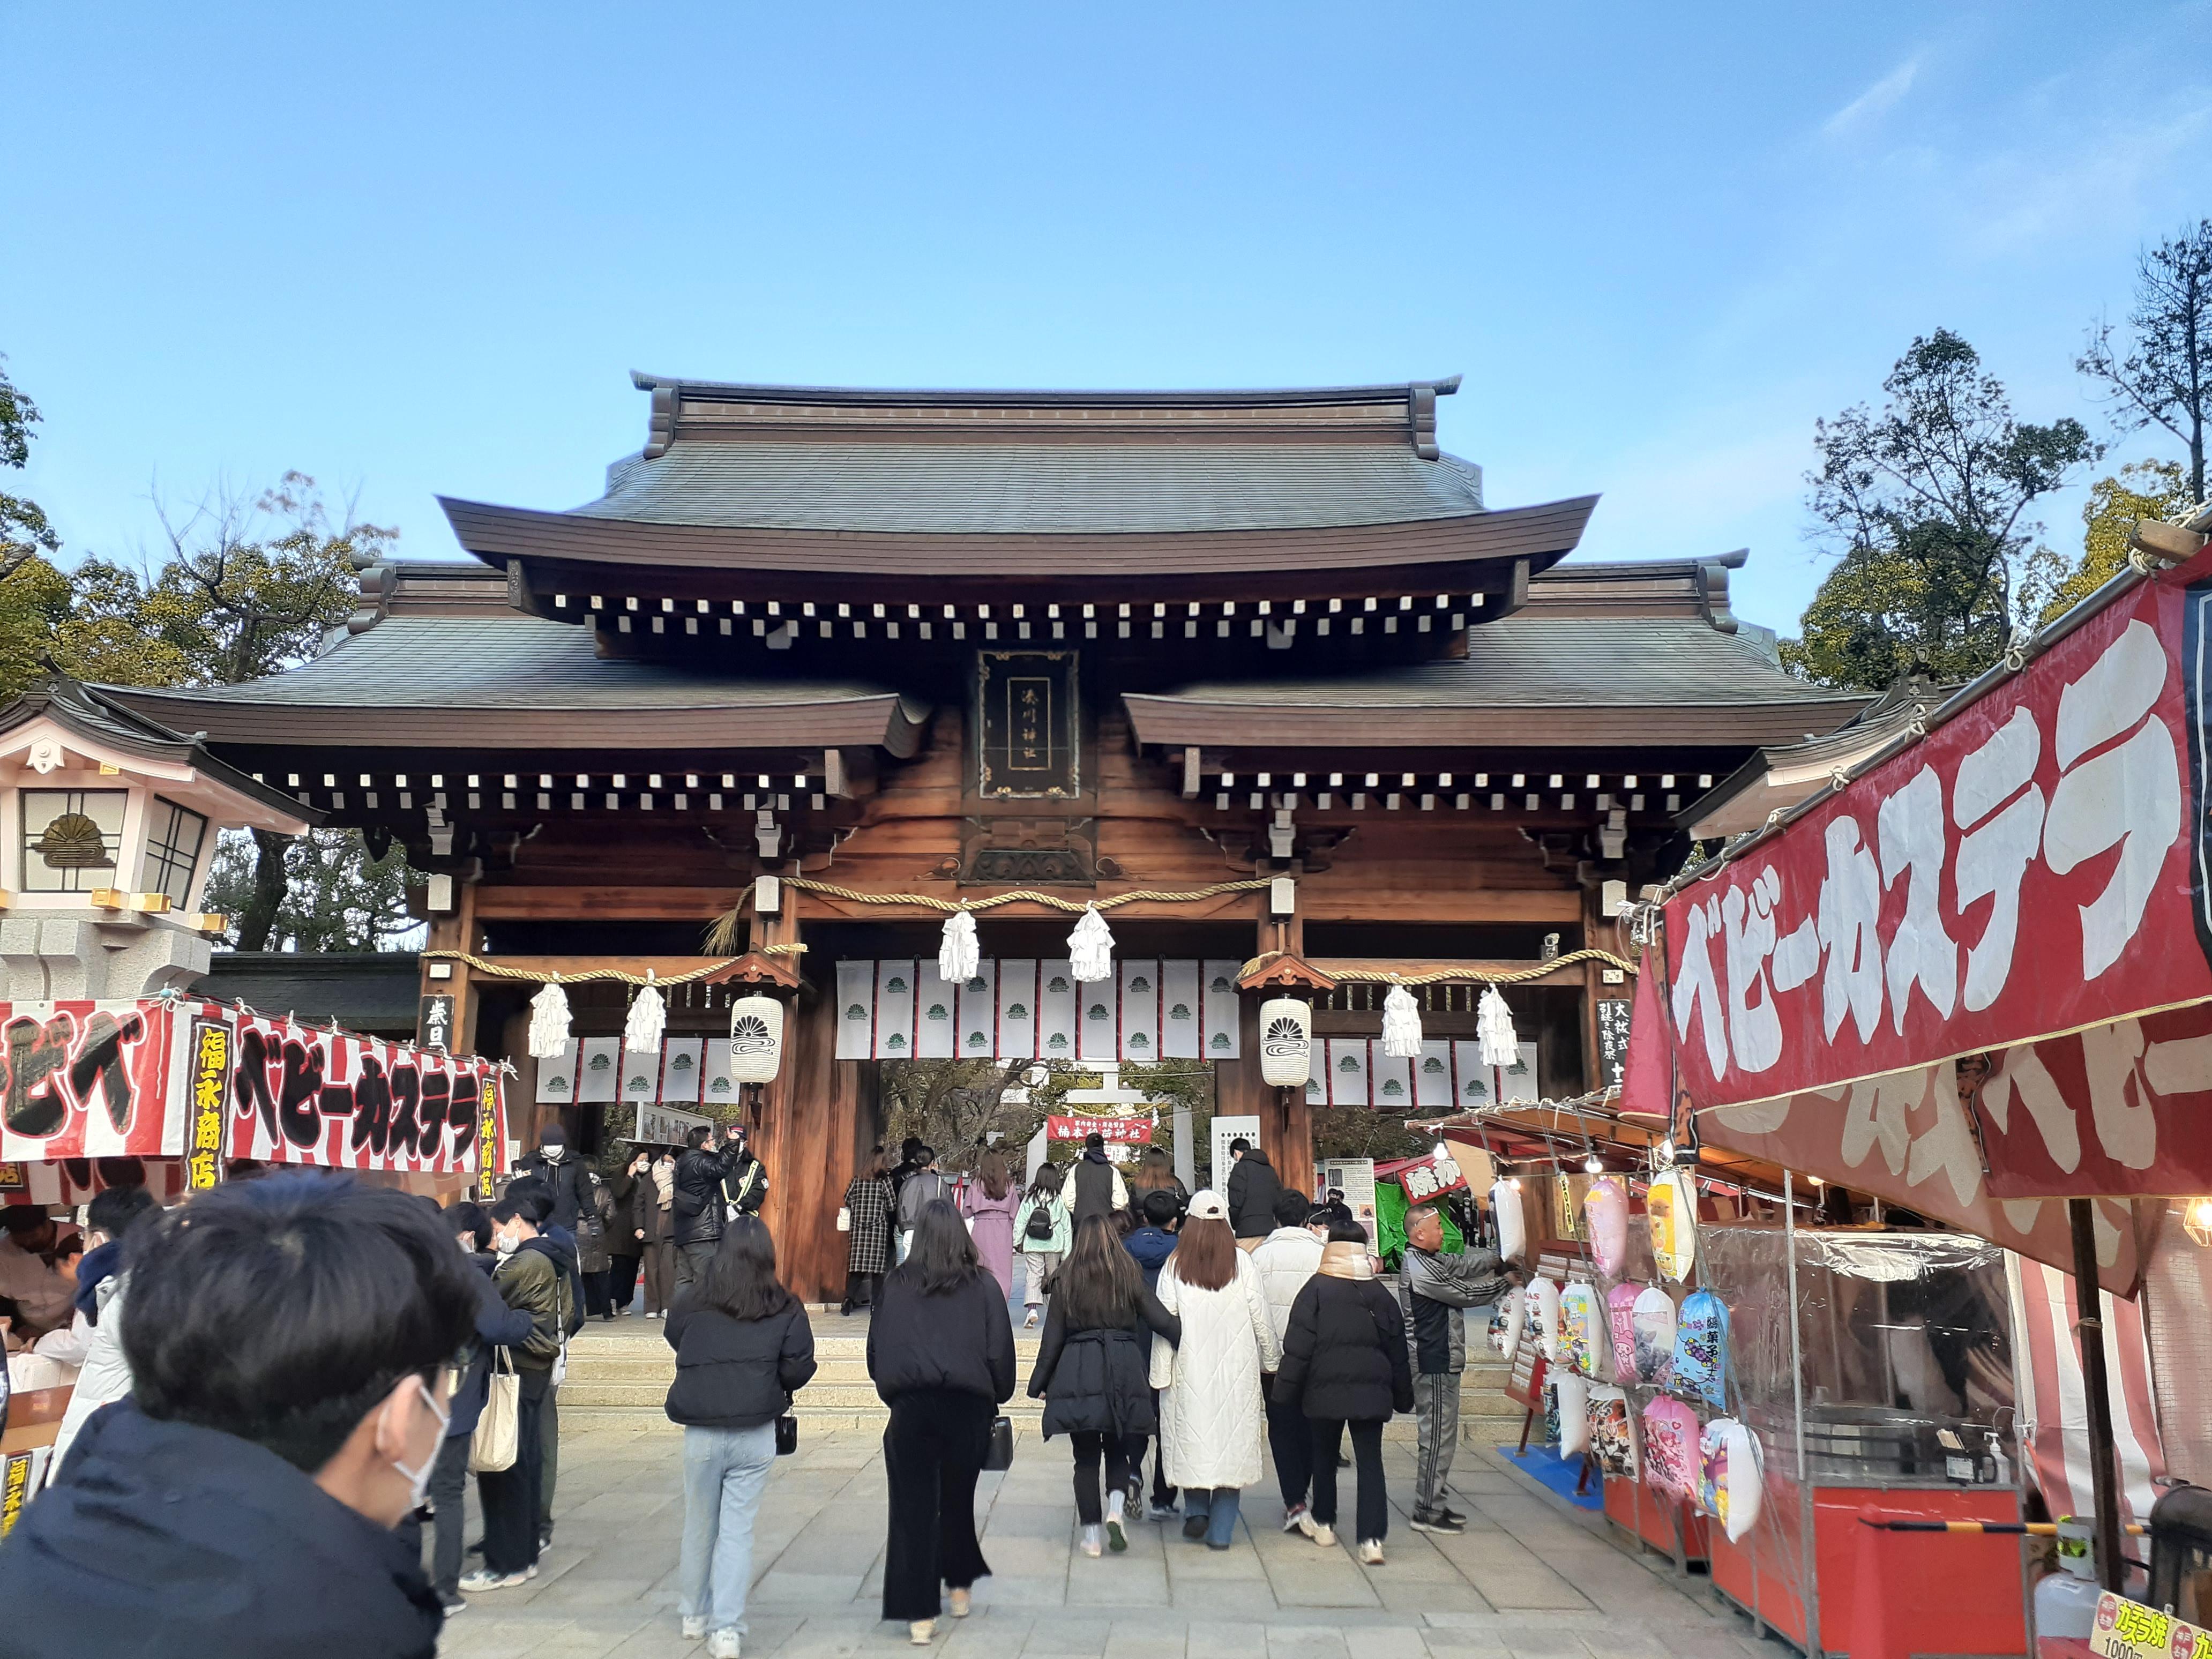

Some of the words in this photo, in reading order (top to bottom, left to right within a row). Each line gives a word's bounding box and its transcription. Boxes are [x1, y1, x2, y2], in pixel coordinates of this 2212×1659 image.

[1673, 618, 2180, 1081] ベビーカステラ
[234, 1026, 479, 1160] ベビーカステラ
[426, 999, 448, 1050] 歳旦
[190, 1027, 226, 1190] 福永商店
